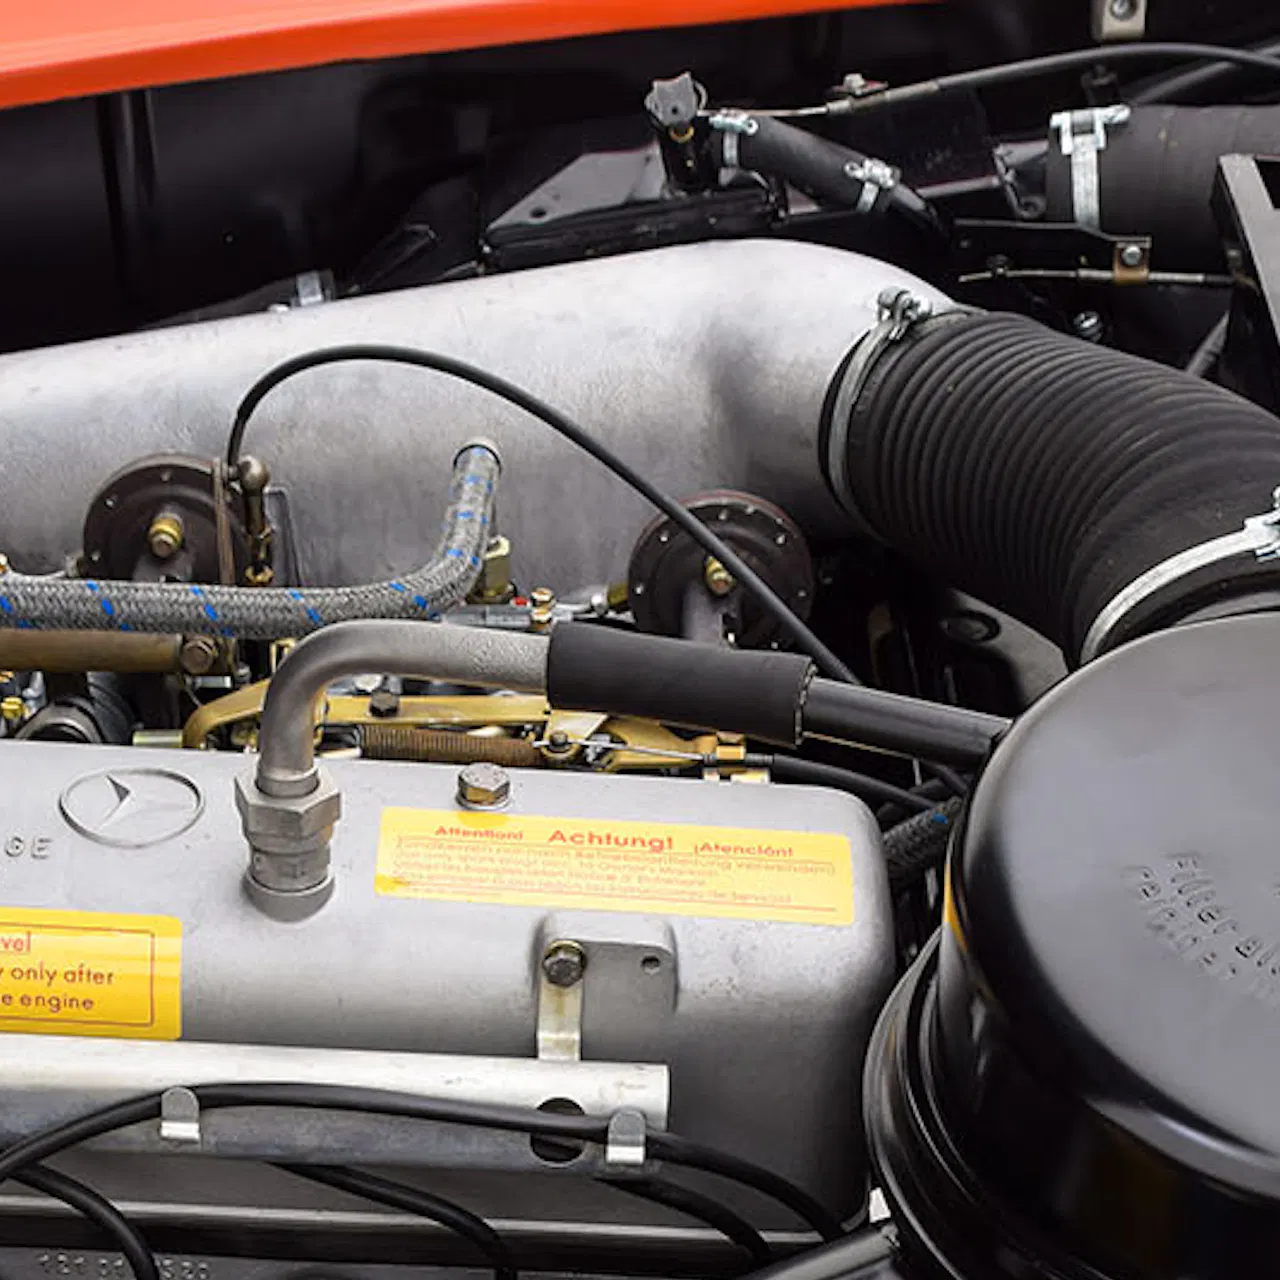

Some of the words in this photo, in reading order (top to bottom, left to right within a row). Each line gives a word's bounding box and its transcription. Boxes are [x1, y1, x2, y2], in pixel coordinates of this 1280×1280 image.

[548, 830, 674, 853] Achtung!
[10, 960, 58, 987] only
[63, 963, 115, 985] after
[19, 993, 95, 1014] engine
